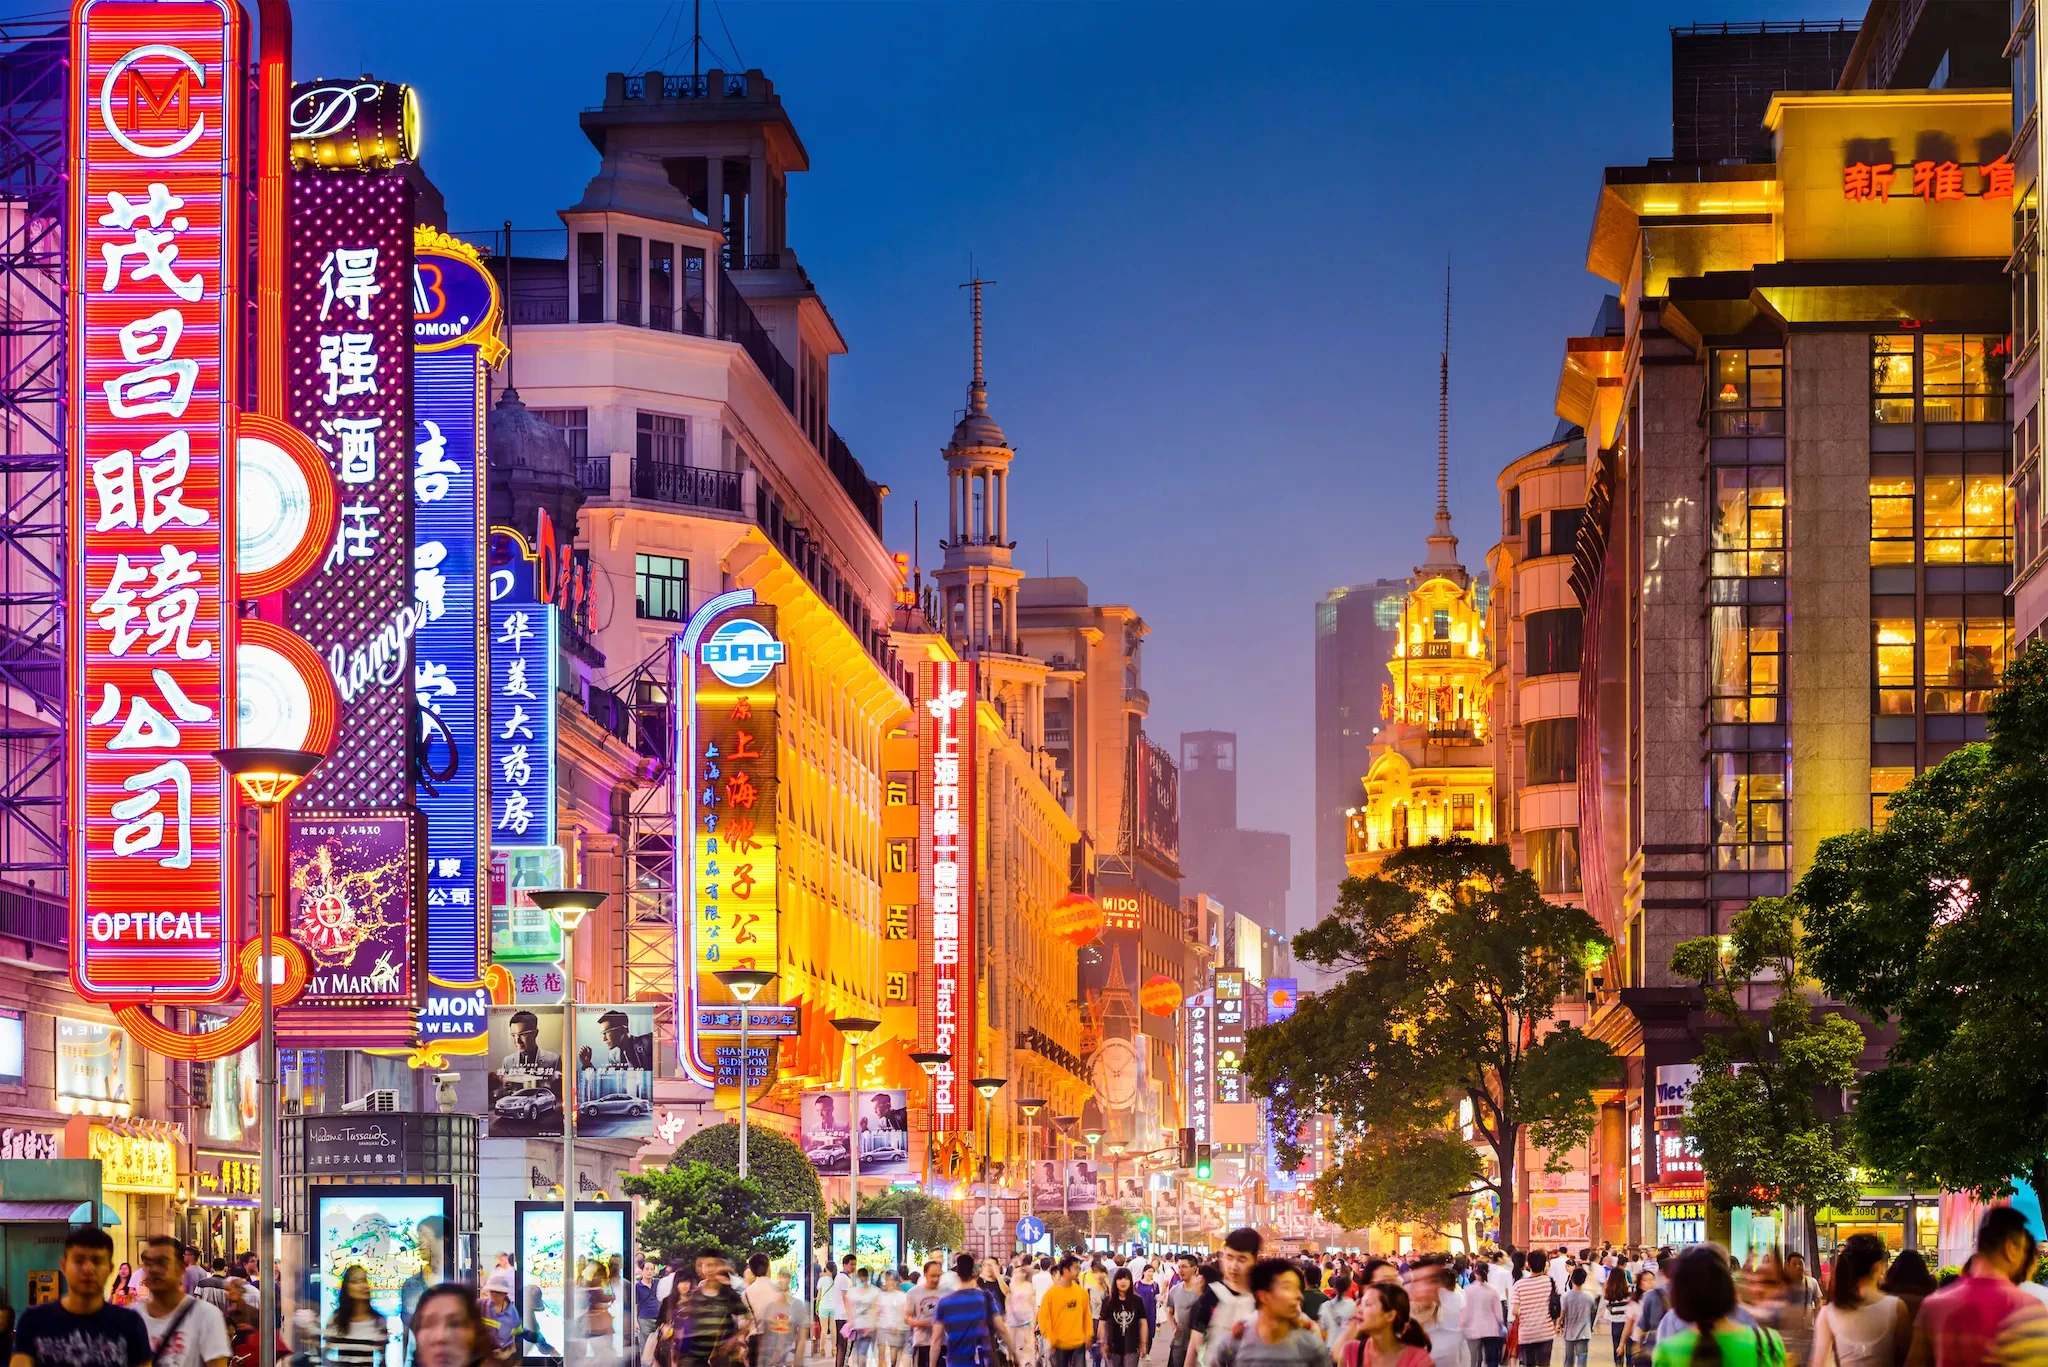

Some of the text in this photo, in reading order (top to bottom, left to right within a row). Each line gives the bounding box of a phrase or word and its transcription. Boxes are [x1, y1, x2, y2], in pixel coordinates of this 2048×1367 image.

[414, 323, 462, 335] OMON
[319, 248, 383, 571] 得强酒庄
[91, 183, 212, 870] 茂昌眼镜公司
[330, 604, 420, 701] hamp
[703, 643, 782, 662] BAC
[497, 611, 536, 835] 华美大药房
[428, 887, 470, 907] 公司
[1102, 896, 1139, 912] MIDO
[91, 911, 212, 941] OPTICAL
[331, 973, 400, 993] MARTIN
[514, 973, 562, 993] 慈菴
[416, 997, 485, 1017] MON
[426, 1022, 475, 1033] WEAR
[747, 1078, 760, 1086] TD
[309, 1125, 390, 1147] Madame Tussauds
[309, 1154, 396, 1164] 上海杜莎夫人蜡像馆
[1854, 1207, 1876, 1216] 3090
